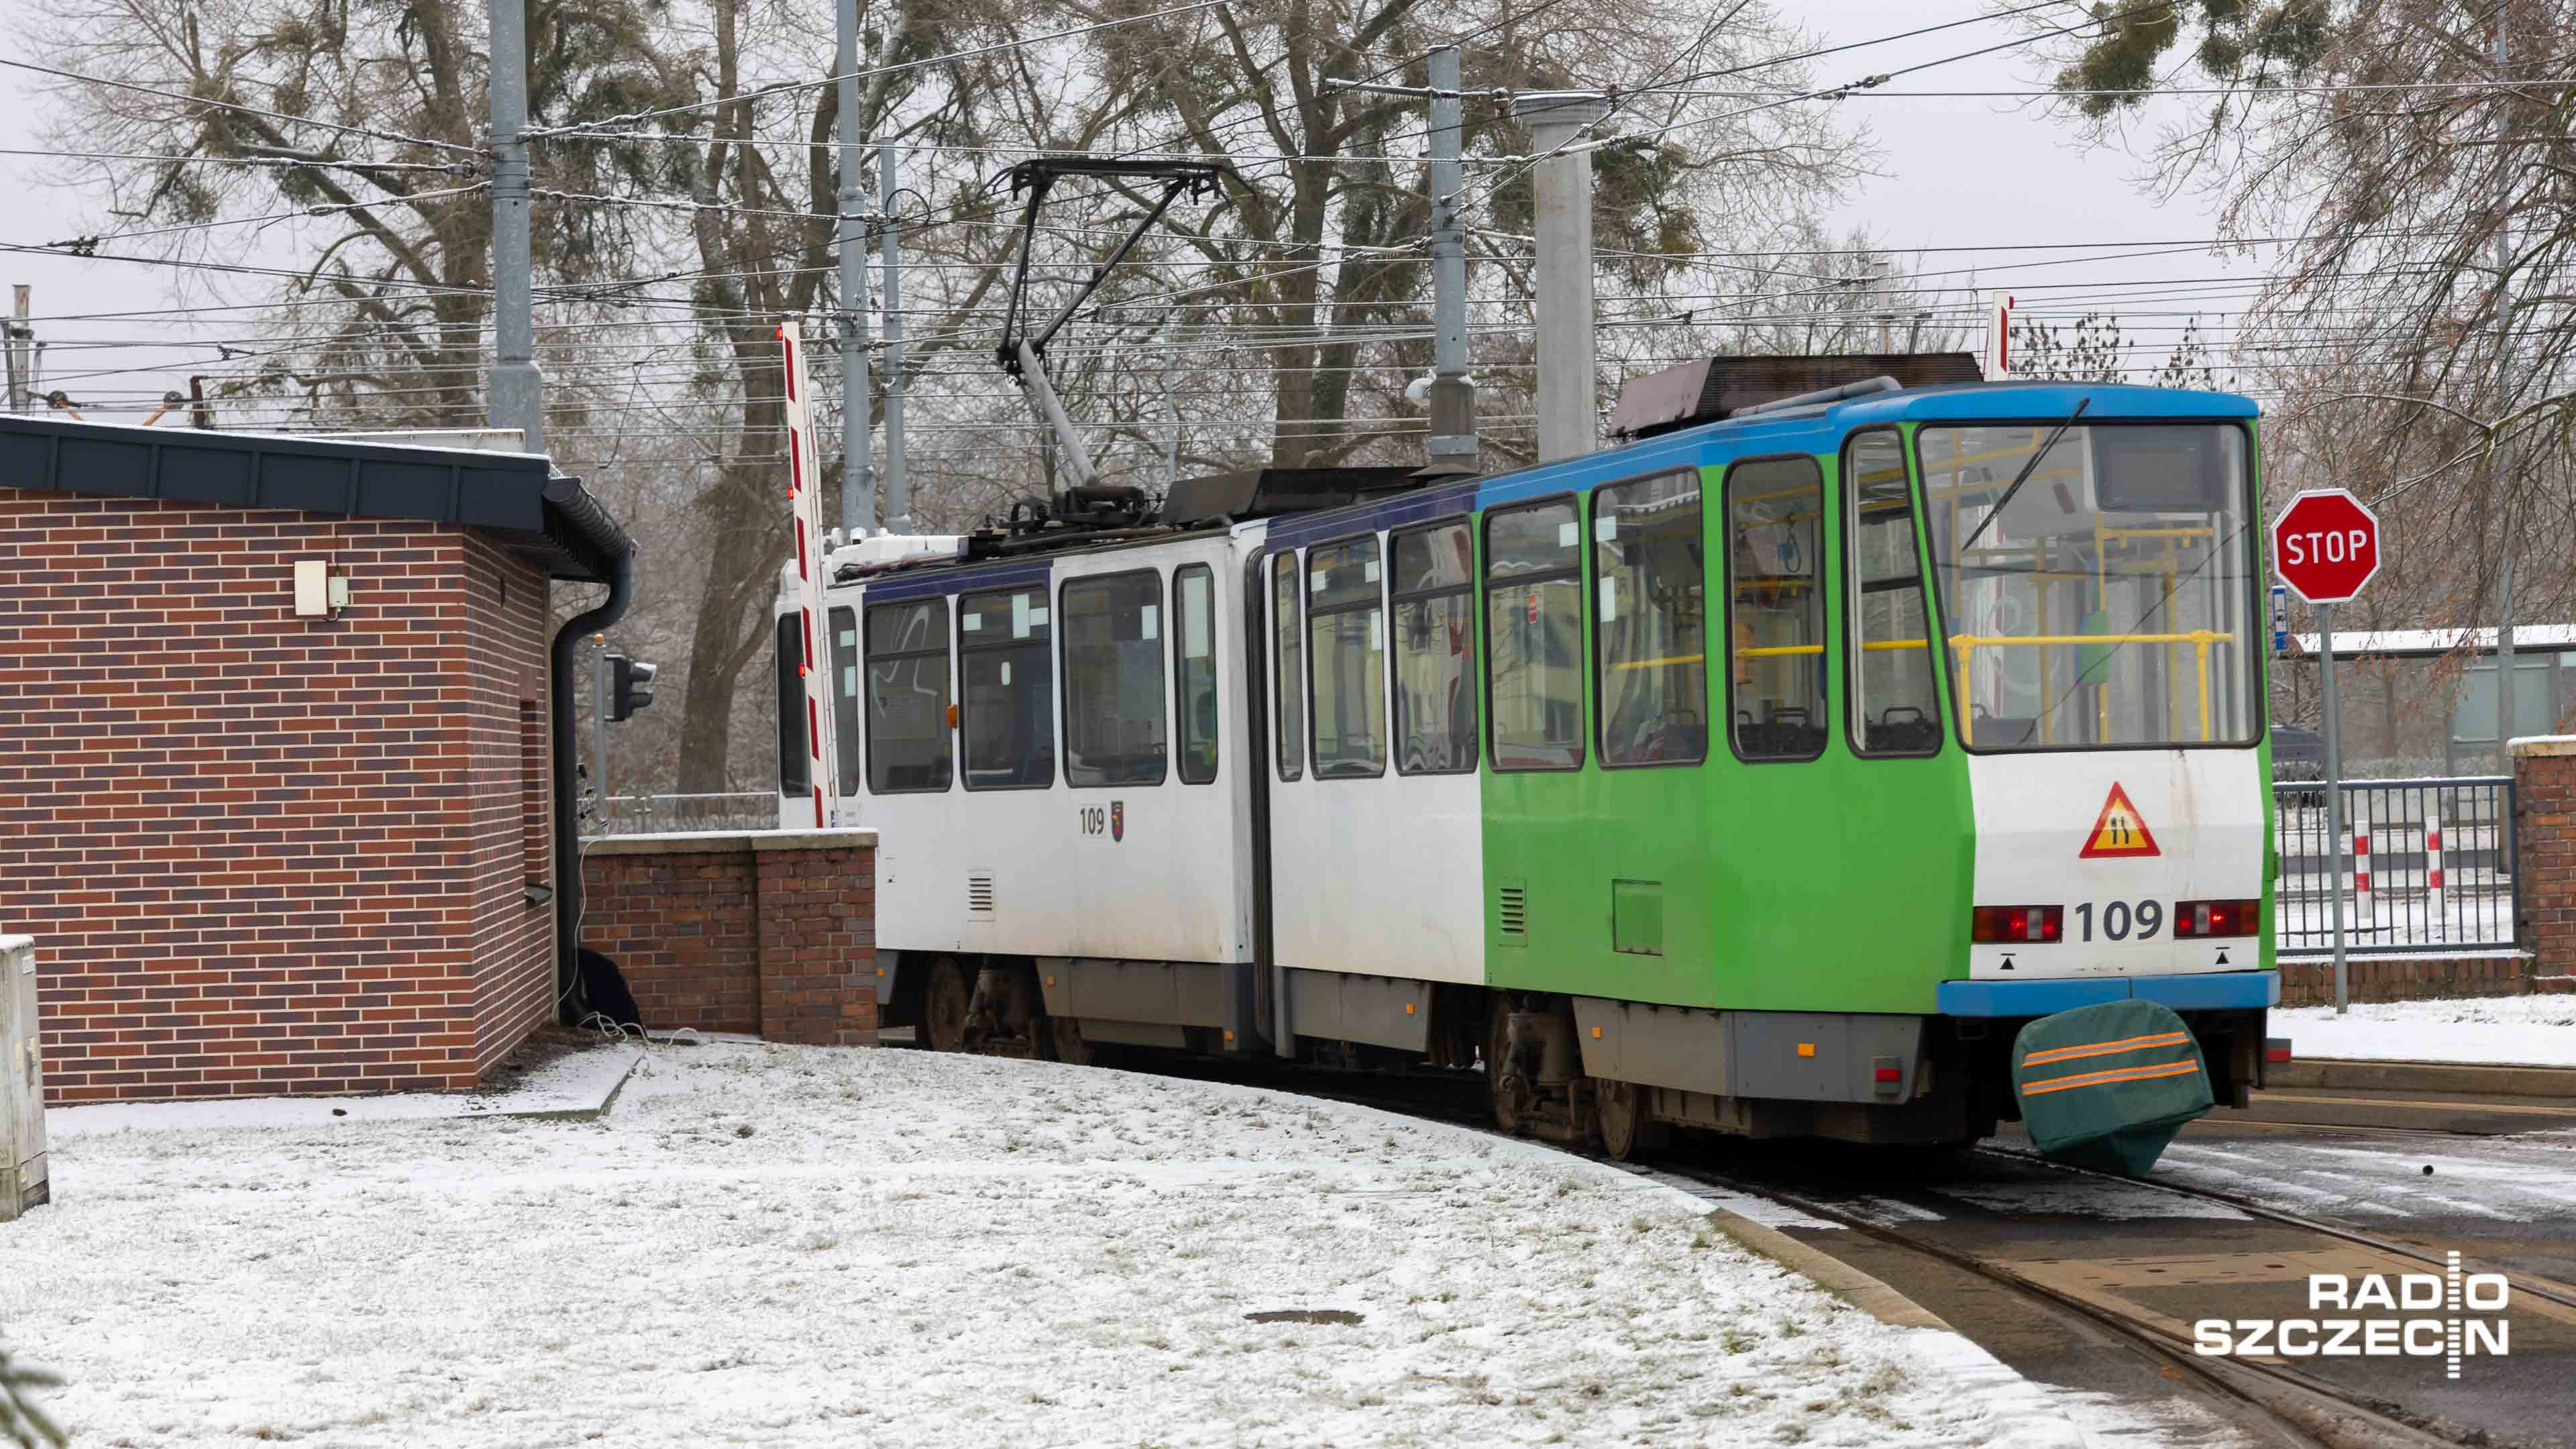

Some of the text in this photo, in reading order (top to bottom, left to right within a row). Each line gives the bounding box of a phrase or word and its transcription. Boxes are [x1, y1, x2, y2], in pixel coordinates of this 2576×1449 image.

[2286, 530, 2367, 565] STOP
[1080, 807, 1104, 835] 109
[2075, 900, 2163, 941] 109
